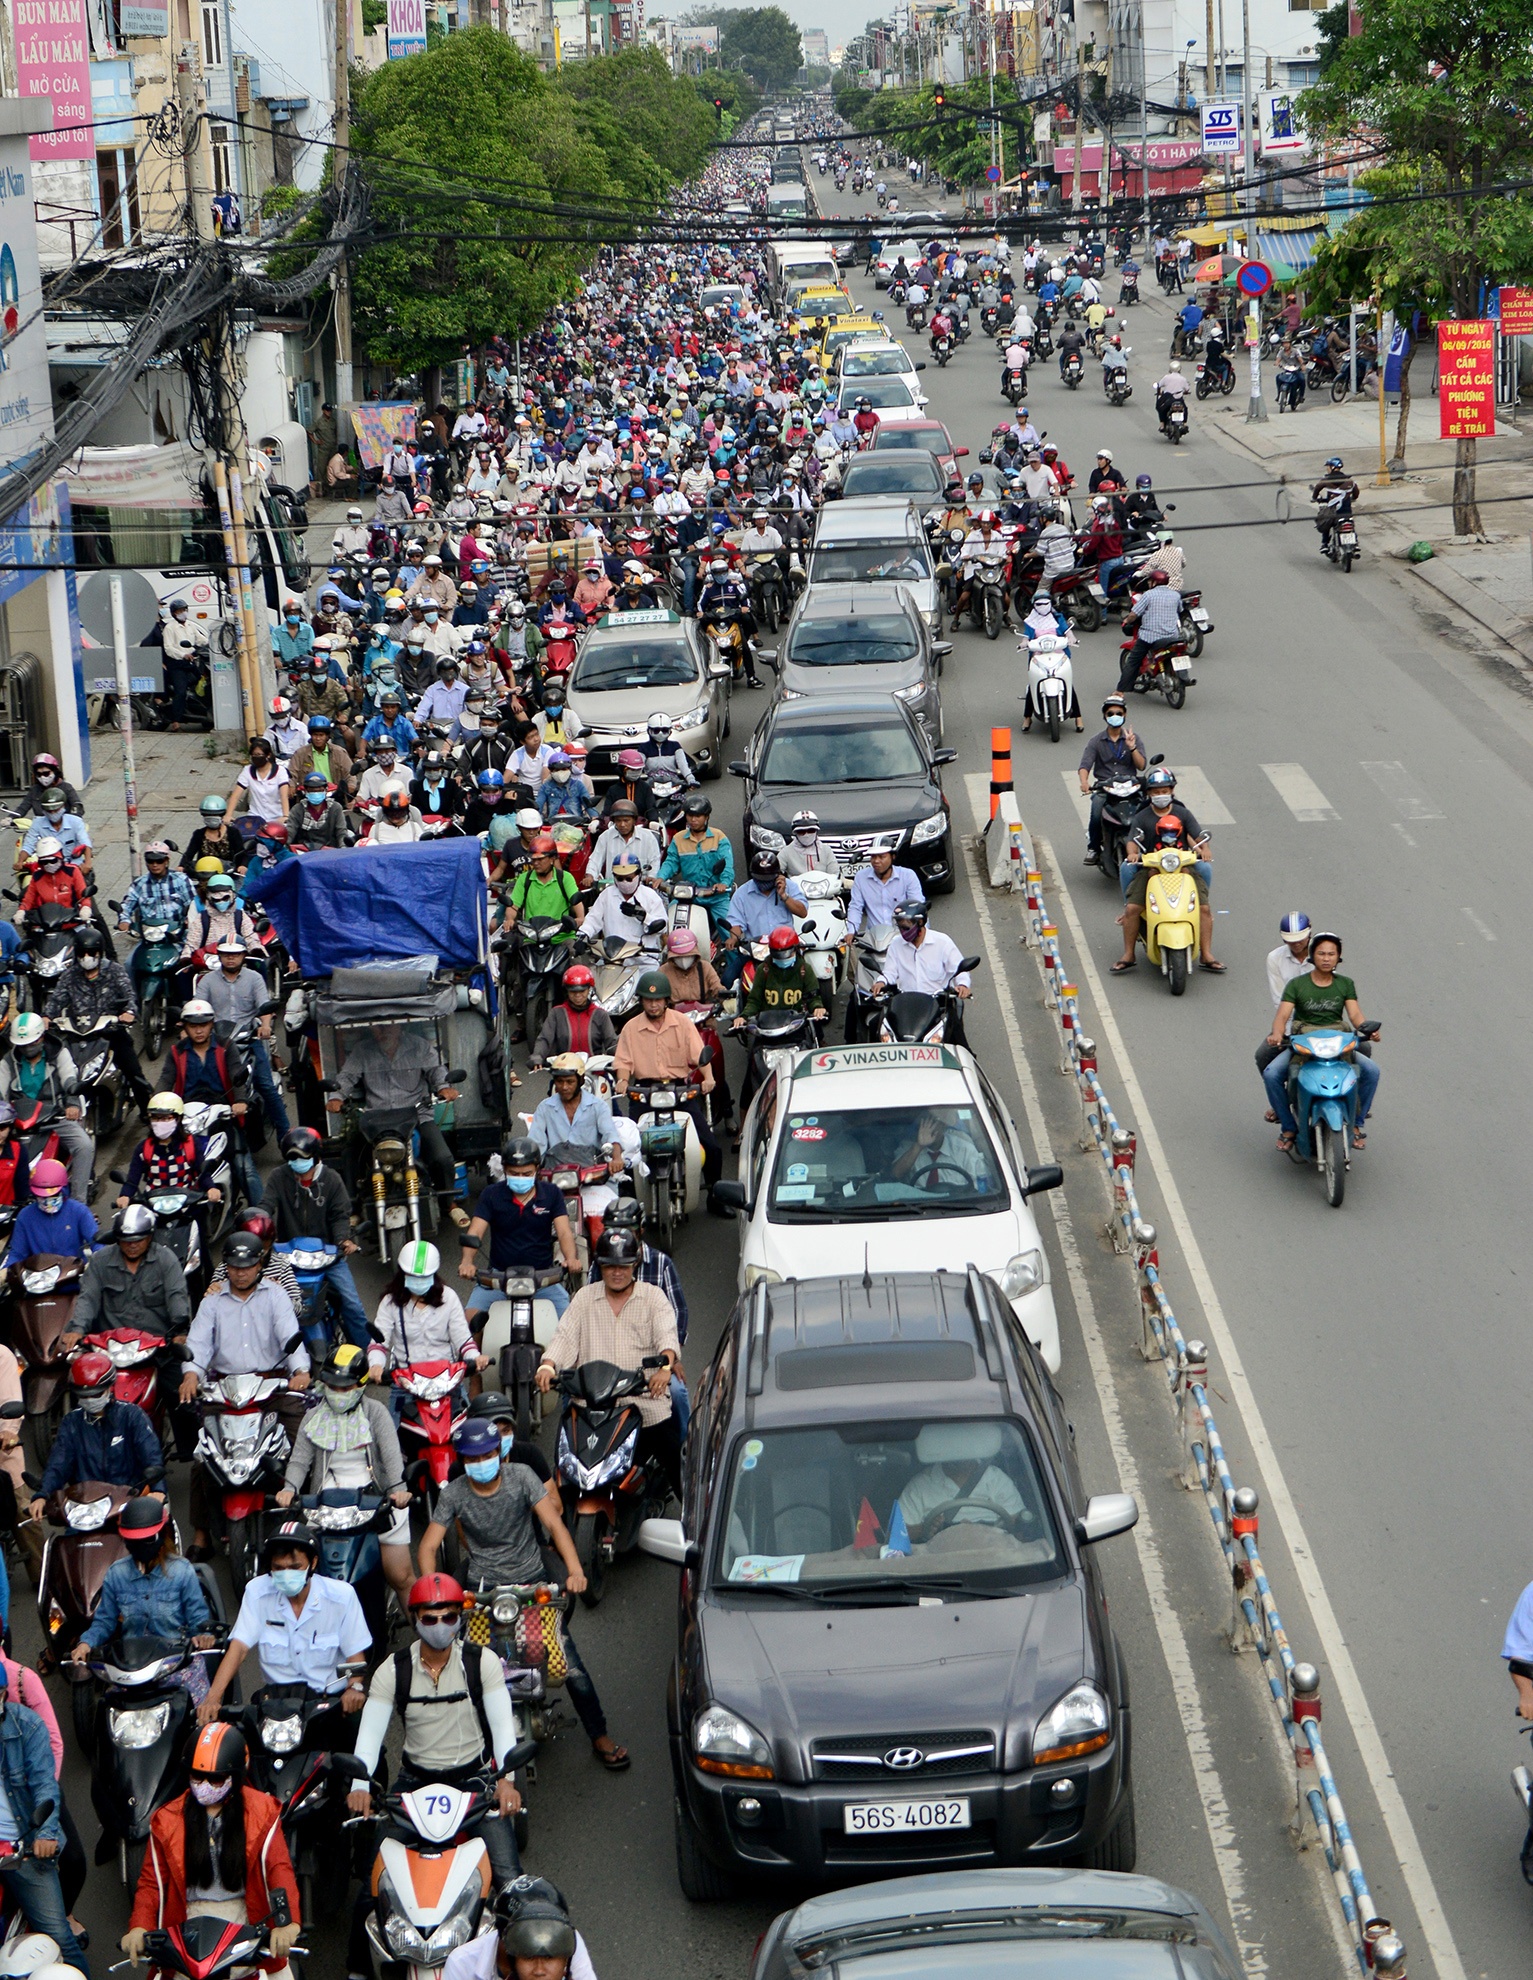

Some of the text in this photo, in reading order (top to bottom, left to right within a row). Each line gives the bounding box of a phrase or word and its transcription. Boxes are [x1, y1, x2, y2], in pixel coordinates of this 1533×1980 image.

[29, 72, 80, 94] MỞ CỬA
[57, 101, 86, 120] sáng
[1205, 110, 1233, 127] STS
[1170, 146, 1187, 159] HÀ
[1461, 322, 1486, 335] NGÀY
[1456, 354, 1476, 369] CẤM
[1440, 371, 1493, 386] TẤT CẢ CÁC
[1456, 406, 1478, 420] TIỆN
[1464, 423, 1486, 434] TRÁI
[783, 989, 802, 1006] GO
[425, 1795, 451, 1815] 79
